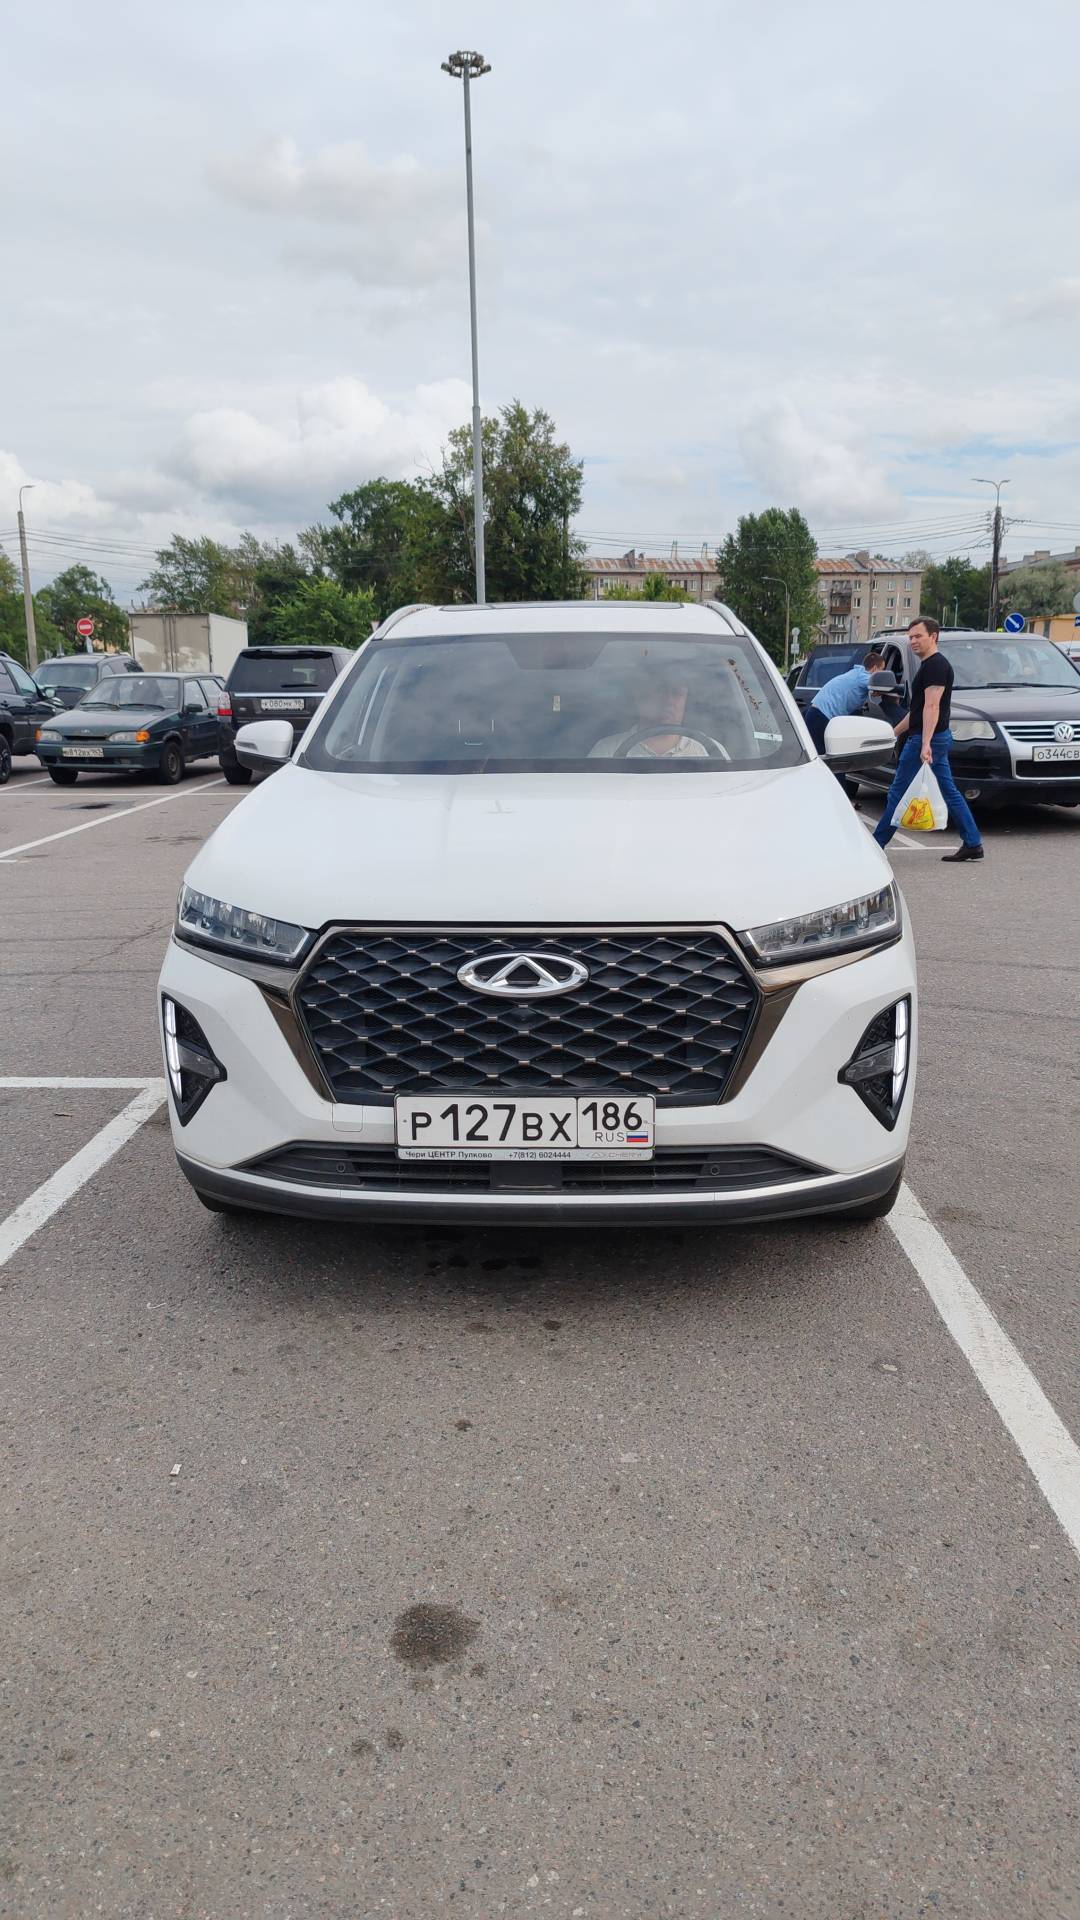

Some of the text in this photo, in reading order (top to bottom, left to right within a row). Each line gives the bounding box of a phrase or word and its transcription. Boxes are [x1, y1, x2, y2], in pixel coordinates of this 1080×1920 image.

[410, 1101, 643, 1142] Р127ВХ 186
[594, 1131, 625, 1142] RUS
[405, 1151, 571, 1160] Чери ЦЕНТР Пулково +7(812) 6024444
